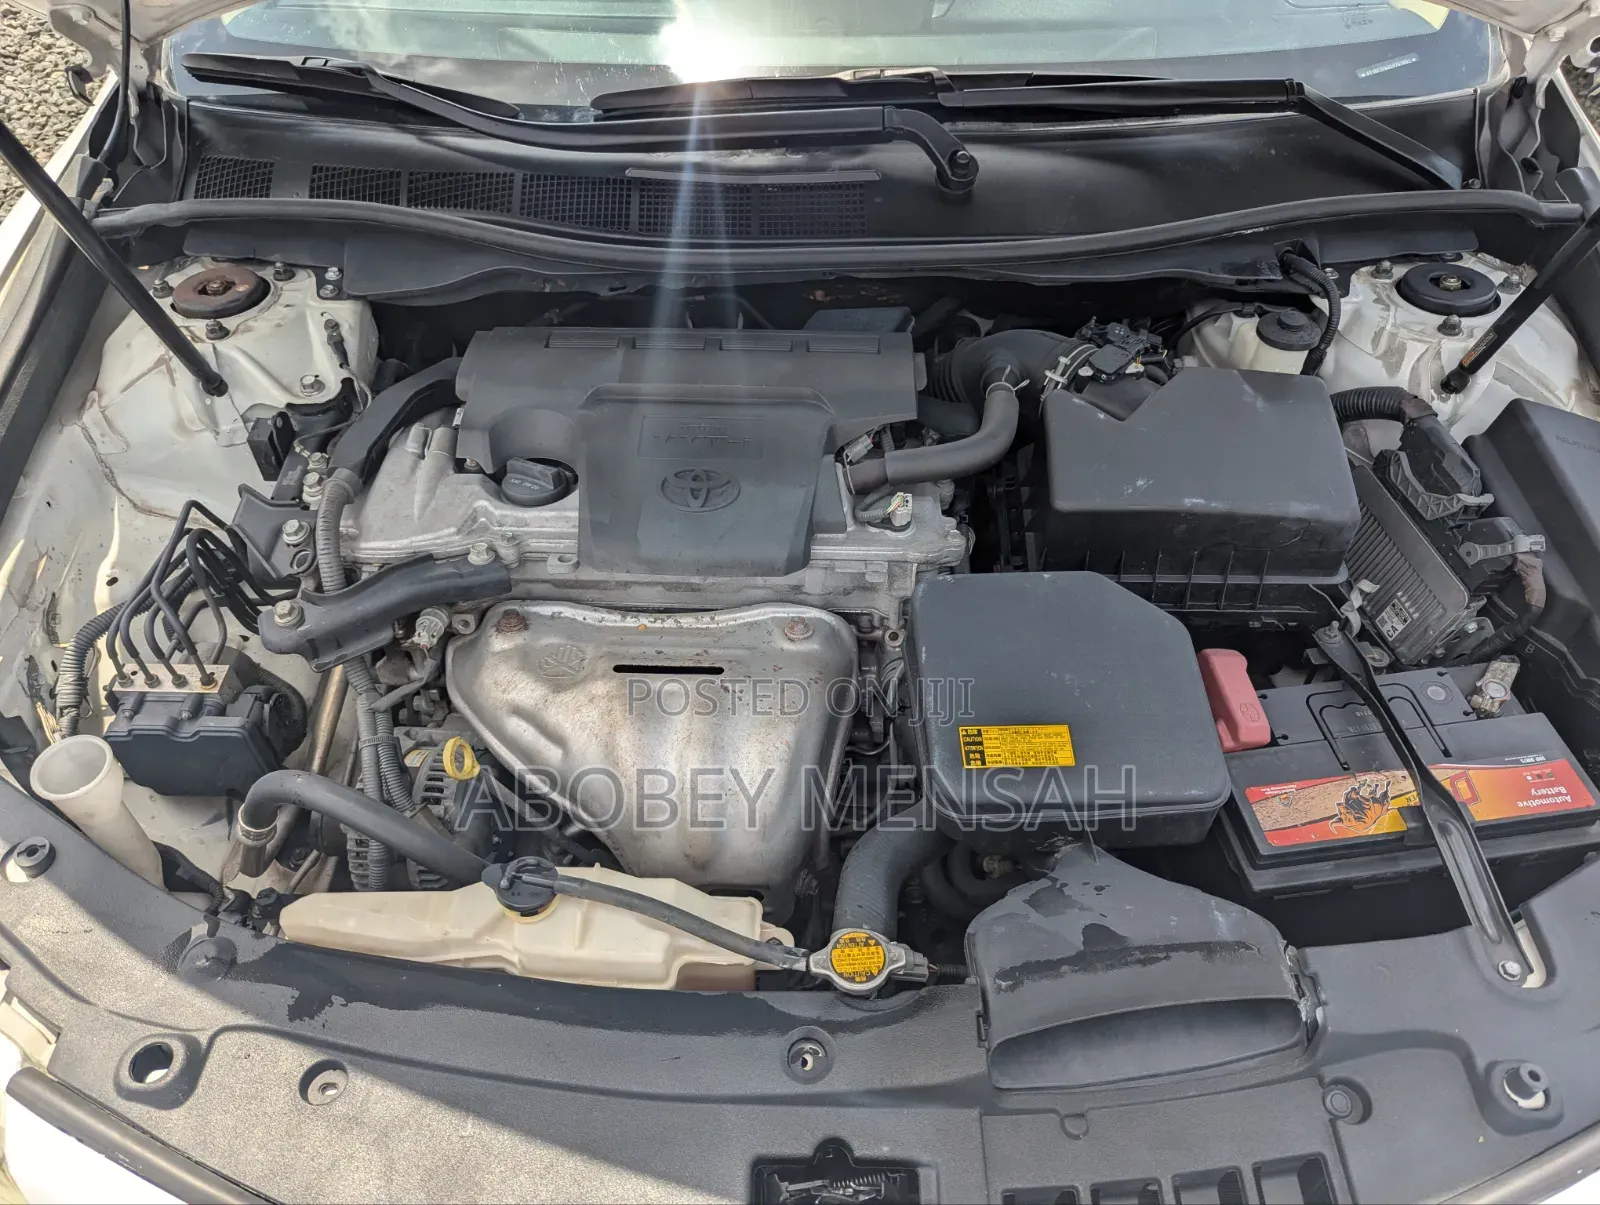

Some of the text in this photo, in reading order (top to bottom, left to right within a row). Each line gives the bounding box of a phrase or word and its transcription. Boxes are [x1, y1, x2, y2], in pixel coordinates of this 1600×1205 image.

[1386, 625, 1399, 638] CA
[1531, 786, 1567, 796] Battery
[1517, 795, 1571, 807] Automotive
